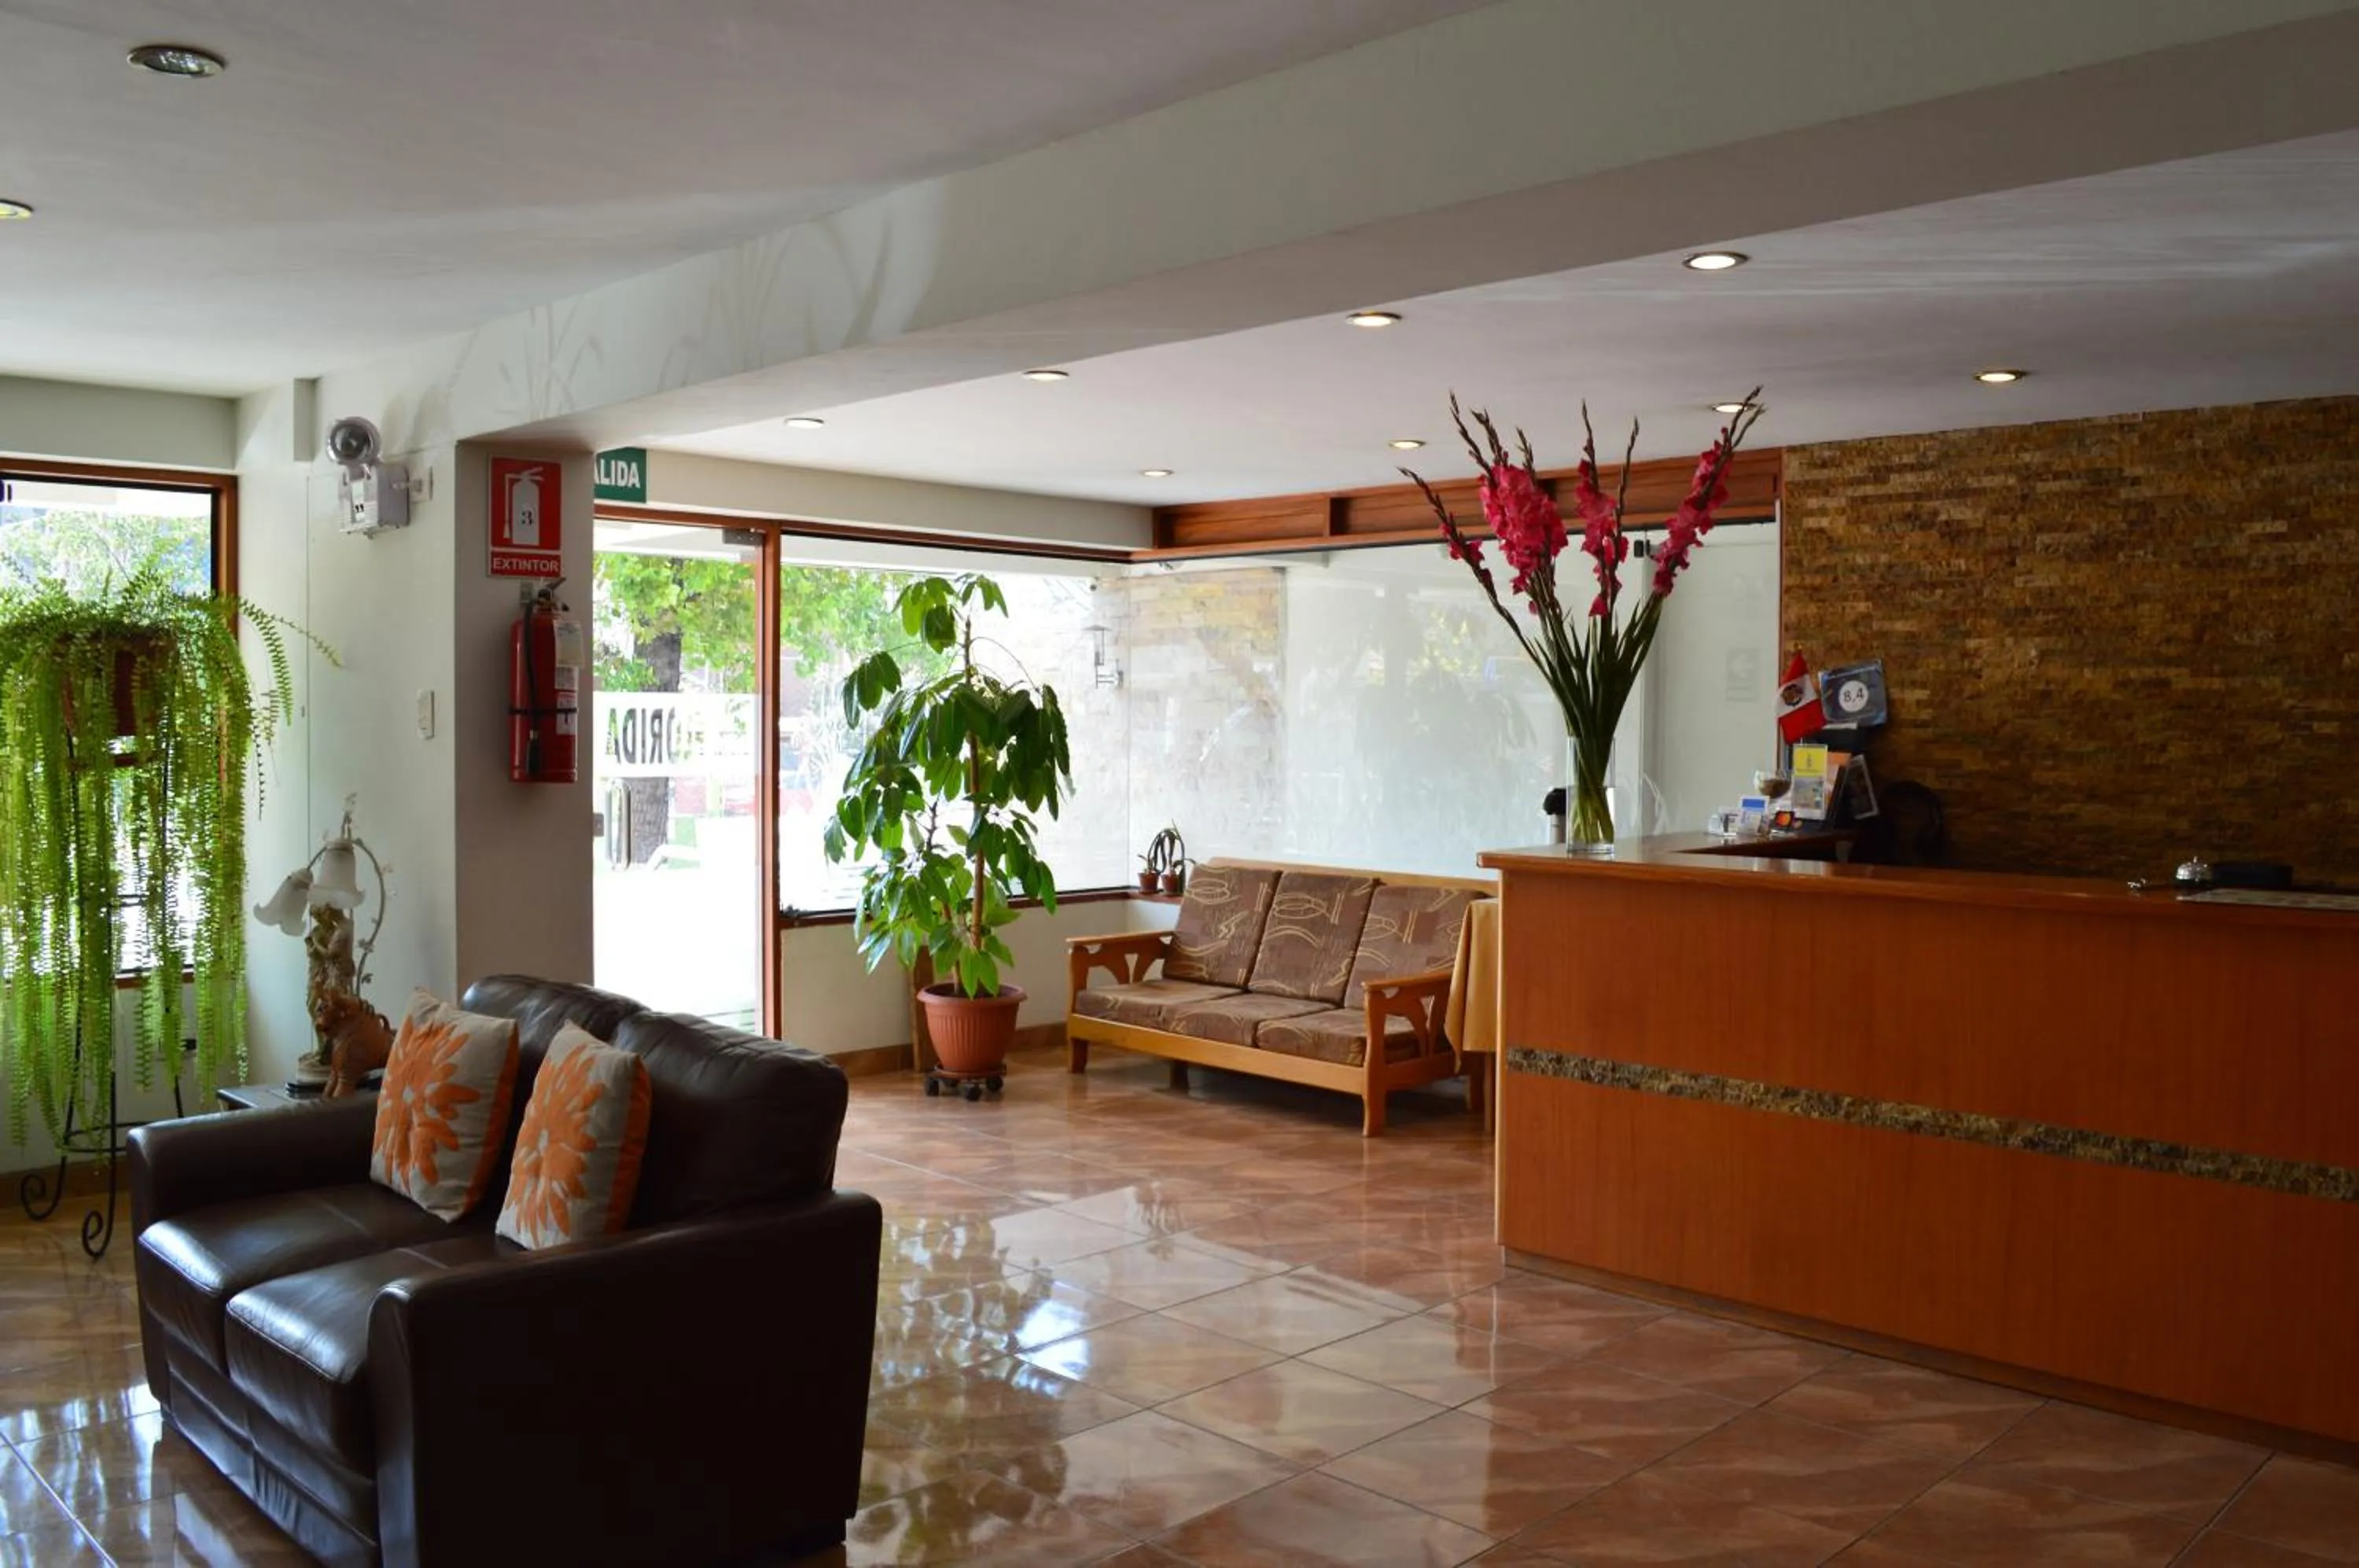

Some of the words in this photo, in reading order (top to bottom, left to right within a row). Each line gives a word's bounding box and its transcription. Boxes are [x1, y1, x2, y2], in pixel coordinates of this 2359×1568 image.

[521, 510, 534, 526] 3
[492, 557, 559, 572] EXTINTOR
[1842, 686, 1865, 704] 8,4
